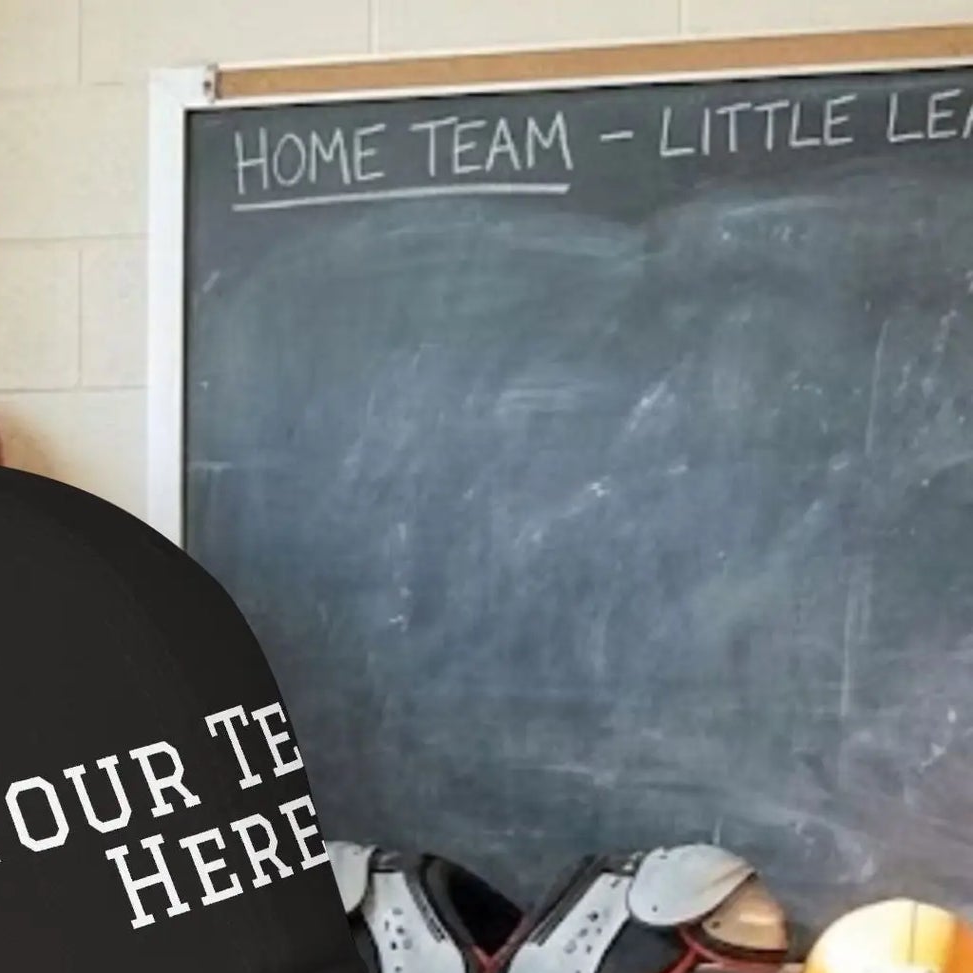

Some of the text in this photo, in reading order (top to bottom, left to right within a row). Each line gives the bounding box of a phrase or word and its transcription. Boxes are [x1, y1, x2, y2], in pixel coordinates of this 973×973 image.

[234, 122, 387, 195] HOME
[409, 110, 574, 178] TEAM
[659, 94, 858, 158] LITTLE
[204, 701, 305, 790] TE
[104, 794, 331, 930] HERE
